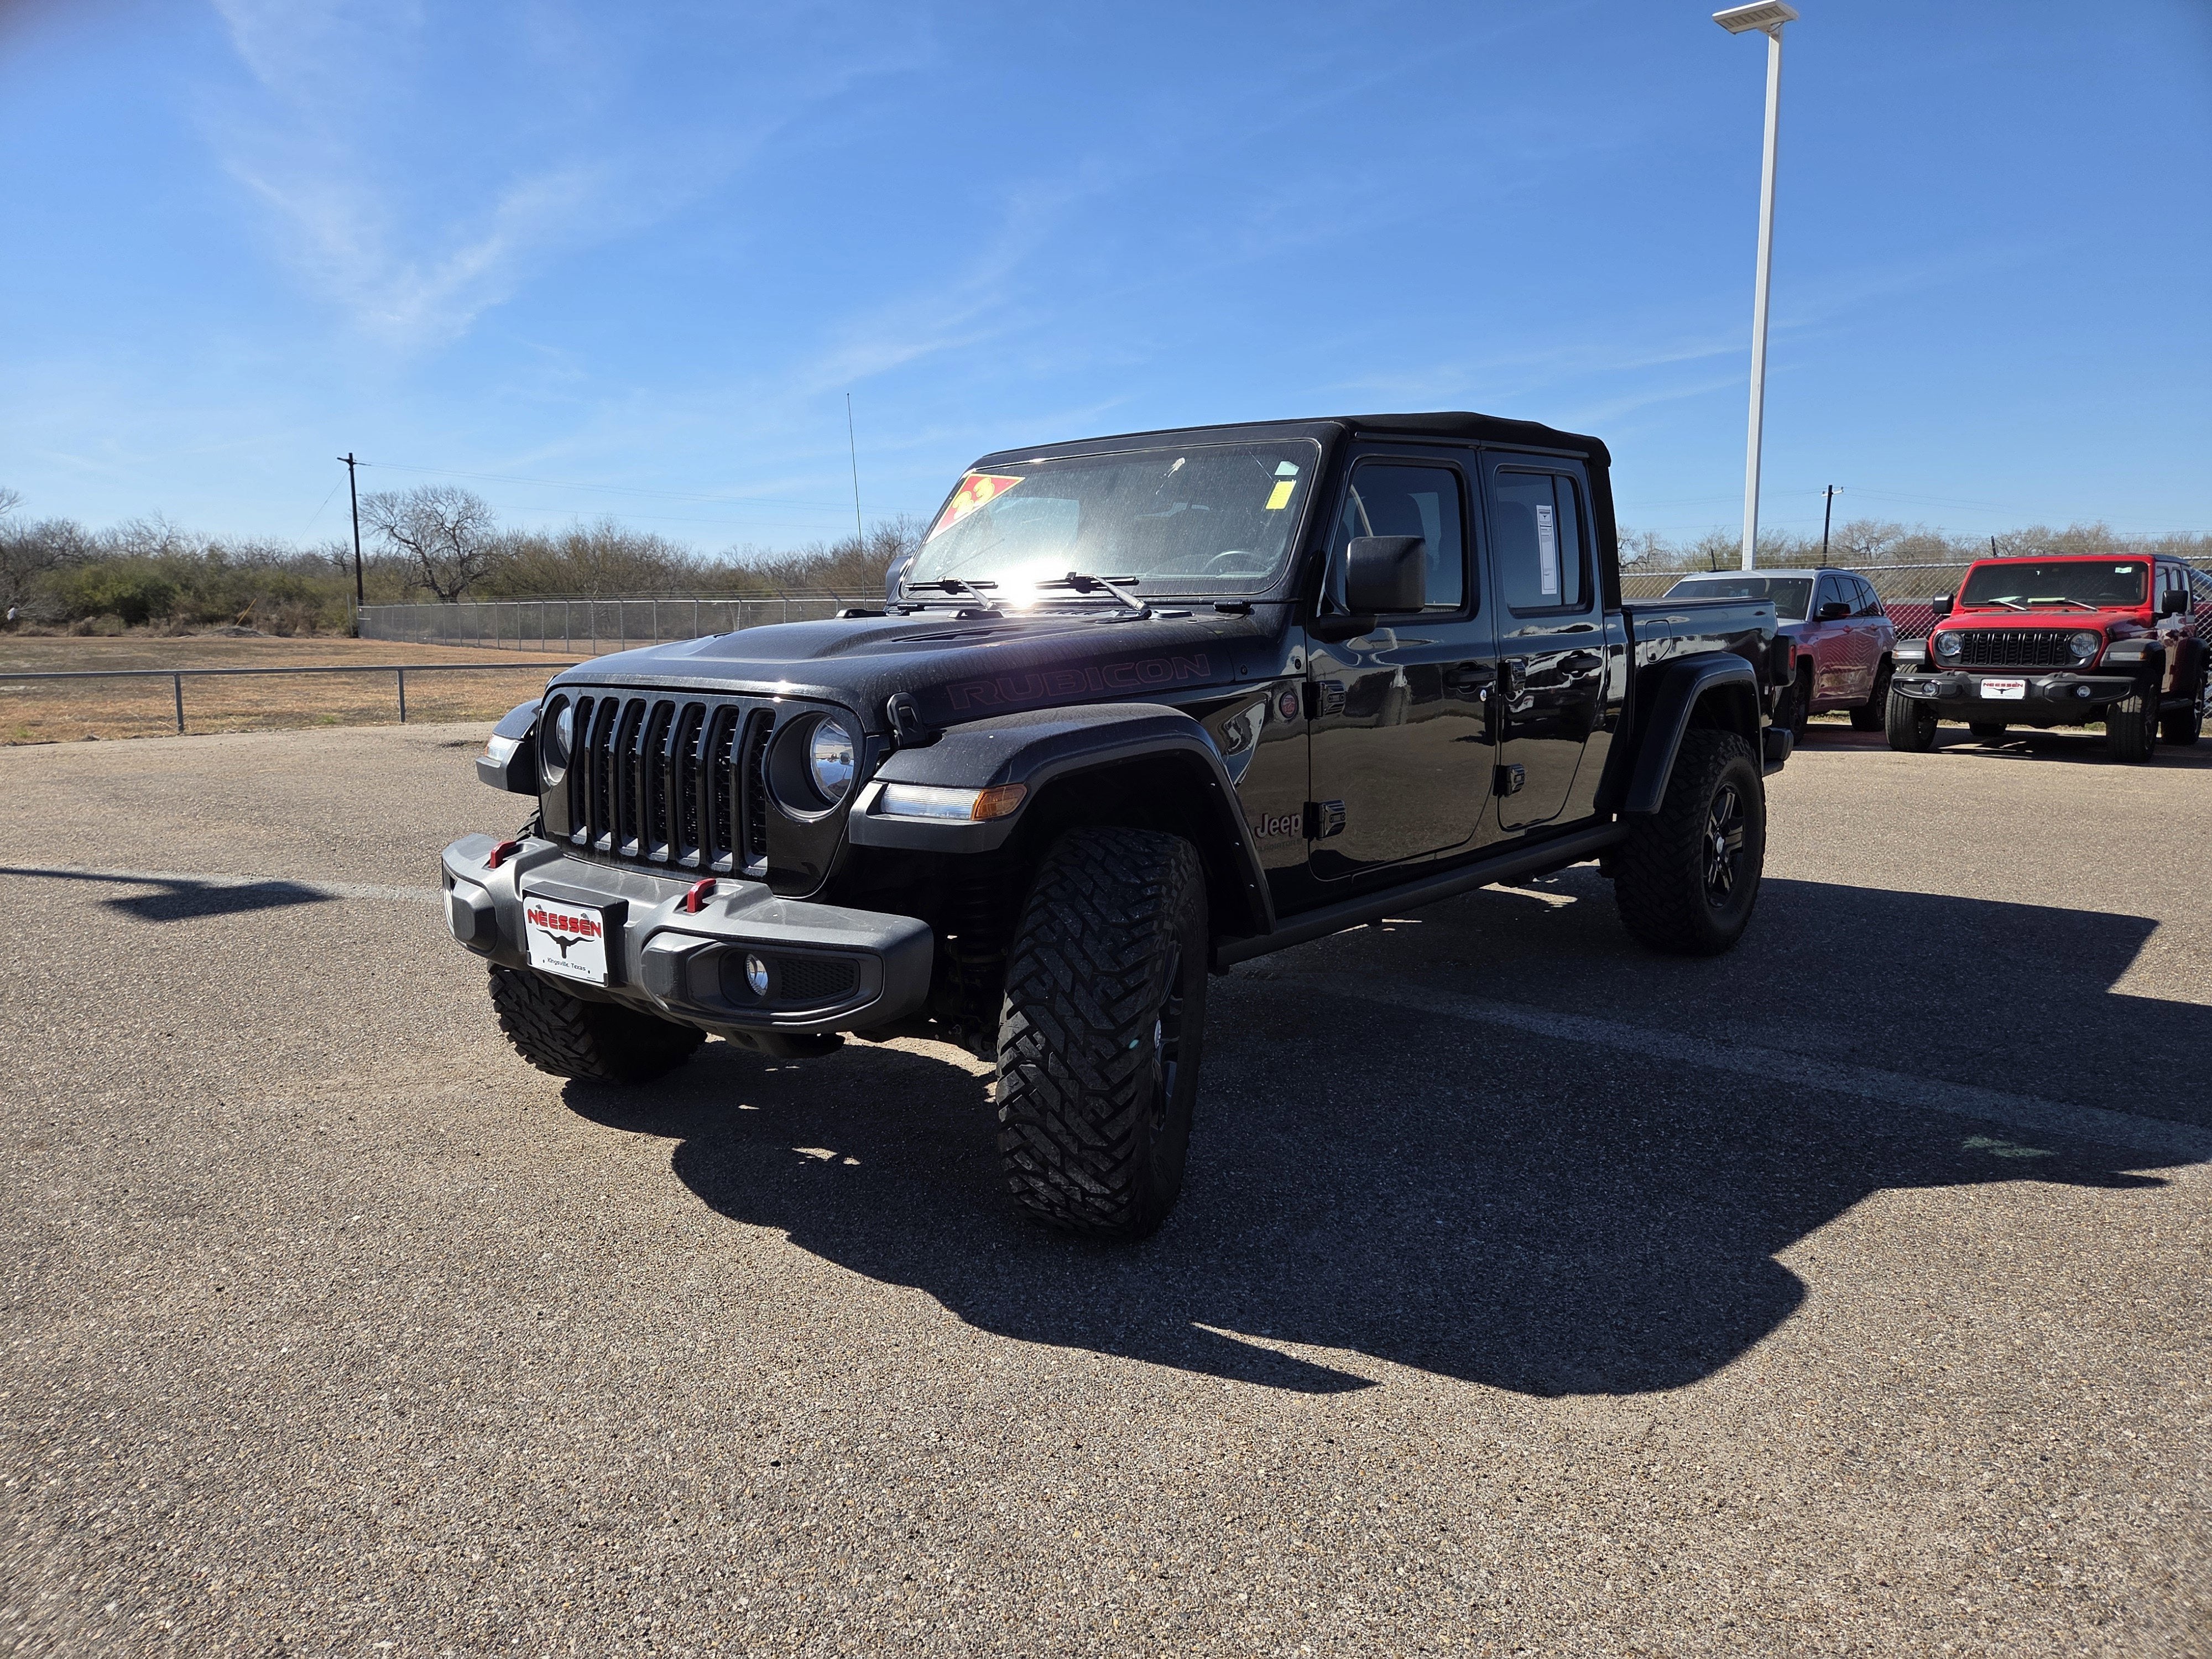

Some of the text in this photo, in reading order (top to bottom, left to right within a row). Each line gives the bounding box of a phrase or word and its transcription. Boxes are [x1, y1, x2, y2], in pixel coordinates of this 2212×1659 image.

[948, 654, 1211, 710] RUBICON
[1255, 812, 1301, 838] Jeep
[527, 909, 602, 938] NEESSEN
